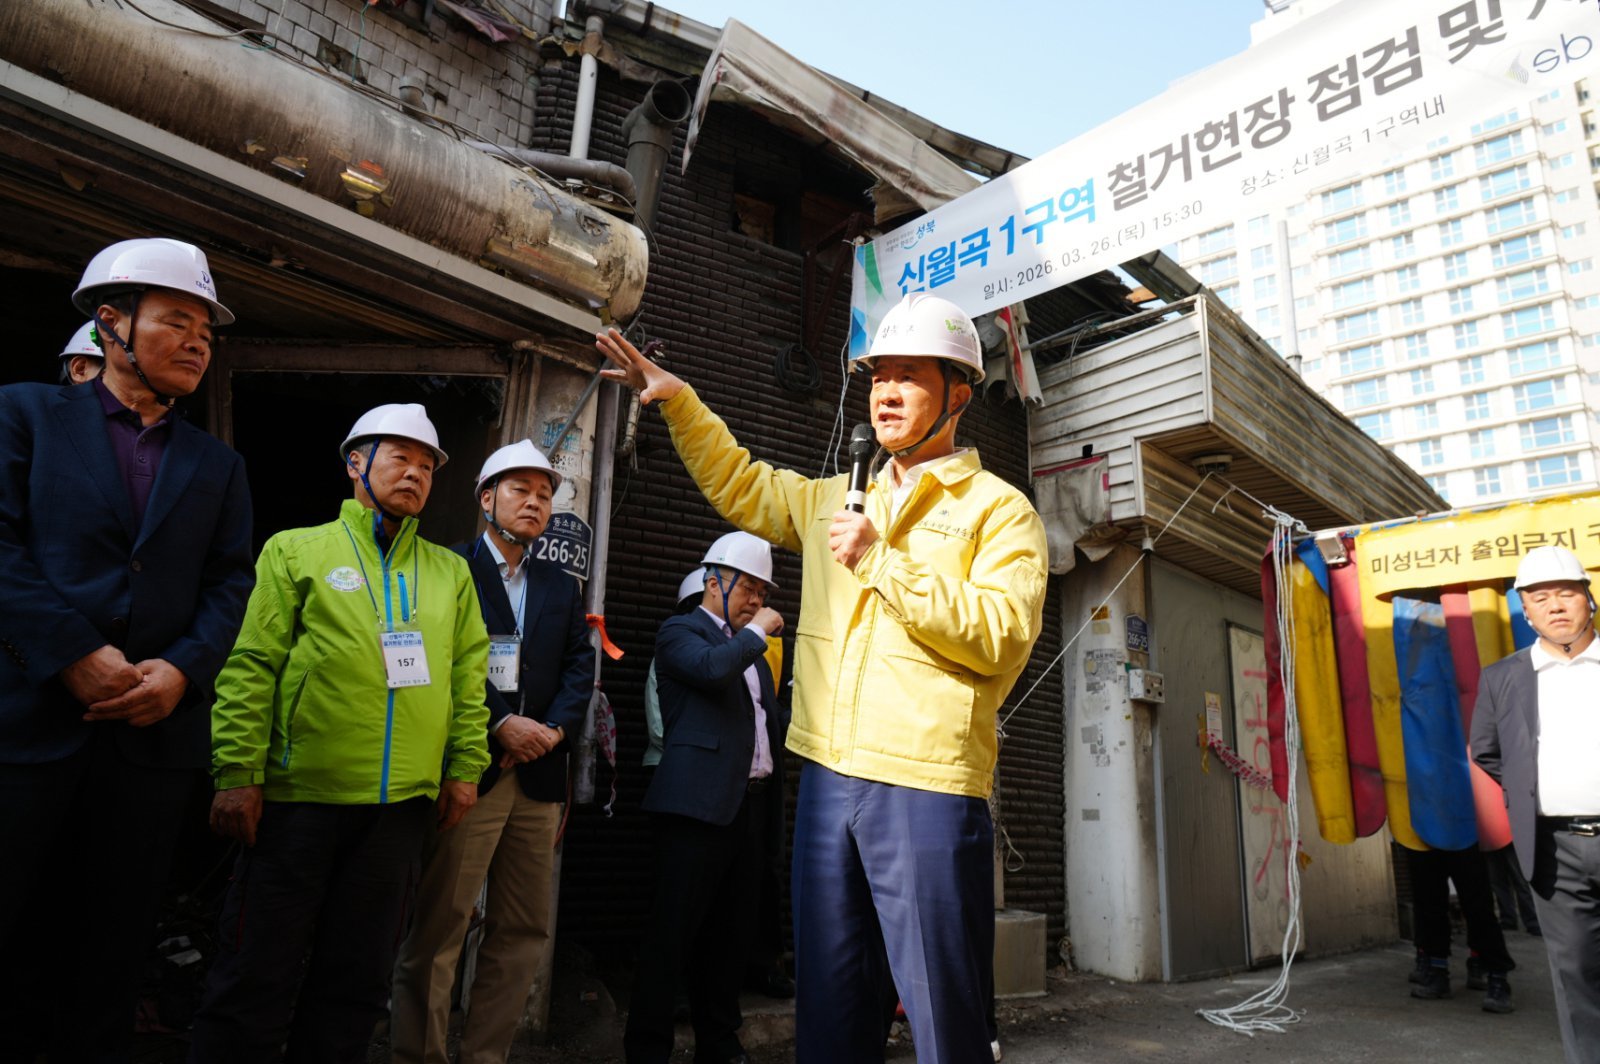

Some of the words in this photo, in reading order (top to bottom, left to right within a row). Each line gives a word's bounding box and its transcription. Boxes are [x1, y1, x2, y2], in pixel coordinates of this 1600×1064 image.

[897, 226, 991, 297] 신월곡
[1106, 88, 1296, 212] 철거현장
[1307, 26, 1423, 122] 점검
[1438, 0, 1508, 65] 및
[1240, 165, 1285, 197] 장소:
[1292, 136, 1353, 175] 신월곡
[916, 219, 936, 239] 성북
[983, 276, 1013, 300] 일시:
[1017, 262, 1057, 288] 2026.
[1153, 200, 1203, 232] 15:30
[536, 536, 588, 570] 266-25
[1372, 544, 1461, 575] 미성년자
[1470, 528, 1577, 560] 출입금지
[397, 657, 415, 667] 157
